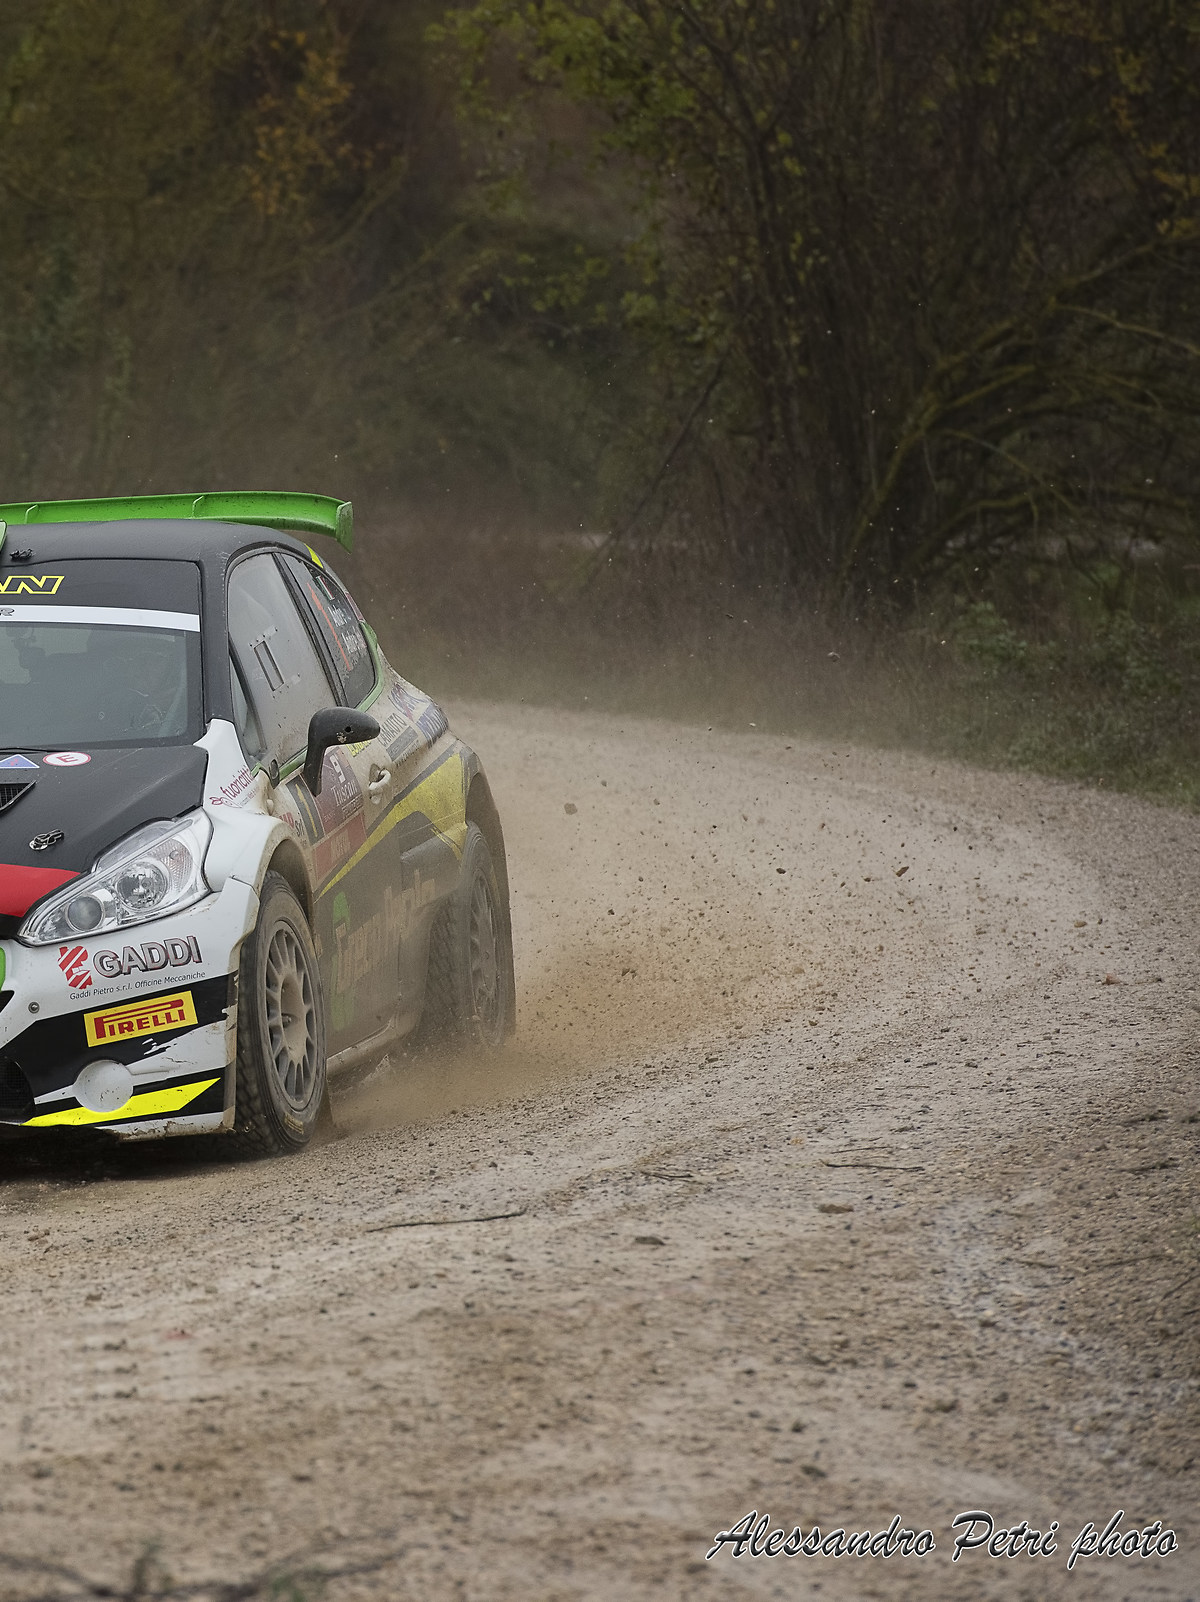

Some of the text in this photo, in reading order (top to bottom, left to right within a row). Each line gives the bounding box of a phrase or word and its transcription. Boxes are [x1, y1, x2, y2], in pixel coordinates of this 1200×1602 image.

[93, 935, 202, 978] GADDI
[69, 970, 206, 1000] Gaddi Pietro s.r.l. Officine Meccaniche
[93, 998, 186, 1040] PIRELLI
